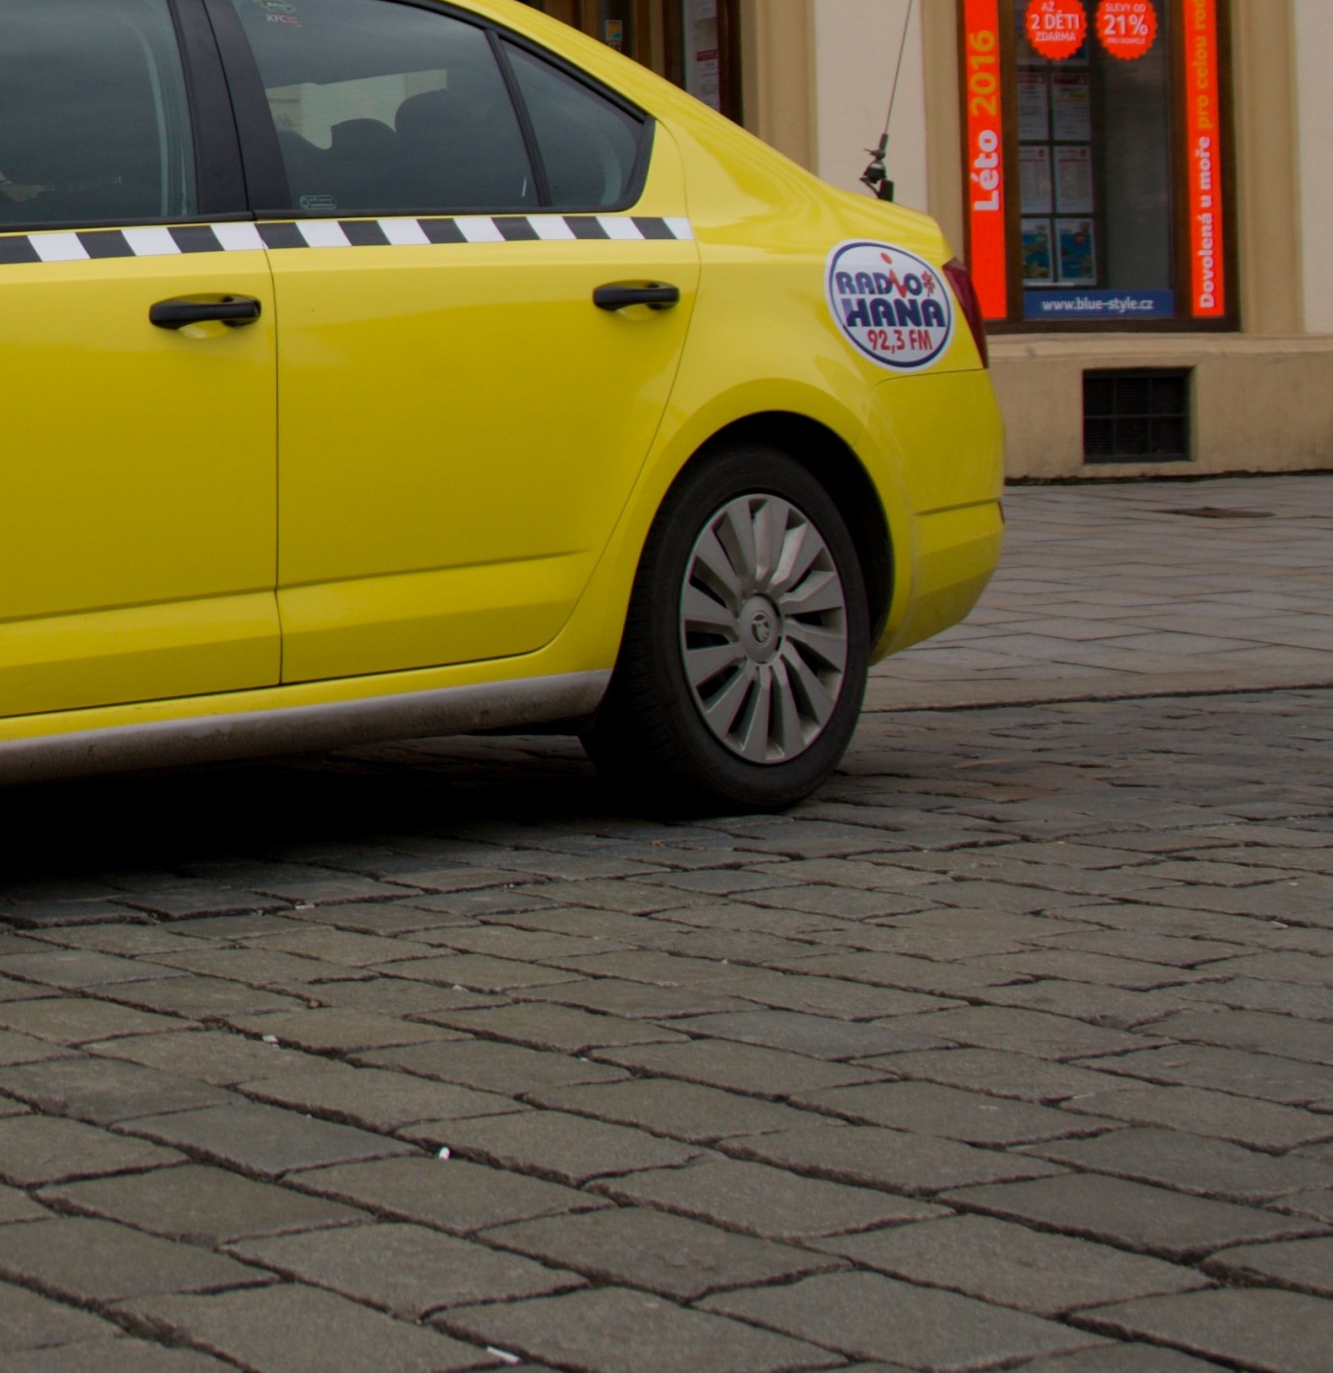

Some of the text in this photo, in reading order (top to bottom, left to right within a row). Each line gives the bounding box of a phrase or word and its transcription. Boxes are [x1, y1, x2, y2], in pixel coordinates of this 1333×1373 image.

[1041, 0, 1055, 11] AŽ
[1105, 3, 1146, 12] SLEVY OD
[1031, 9, 1080, 30] 2 DĚTI
[1104, 14, 1149, 36] 21%
[1036, 31, 1076, 42] ZDARMA
[1193, 36, 1209, 89] celou
[970, 30, 999, 211] Léto 2016
[1197, 95, 1214, 129] pro
[1195, 136, 1211, 189] moře
[1199, 196, 1212, 208] u
[1198, 213, 1215, 308] Dovolená
[835, 258, 923, 298] RADIO
[841, 298, 946, 327] HANA
[1042, 296, 1154, 313] www.blue-style.cz
[867, 329, 933, 354] 92,3 FM
